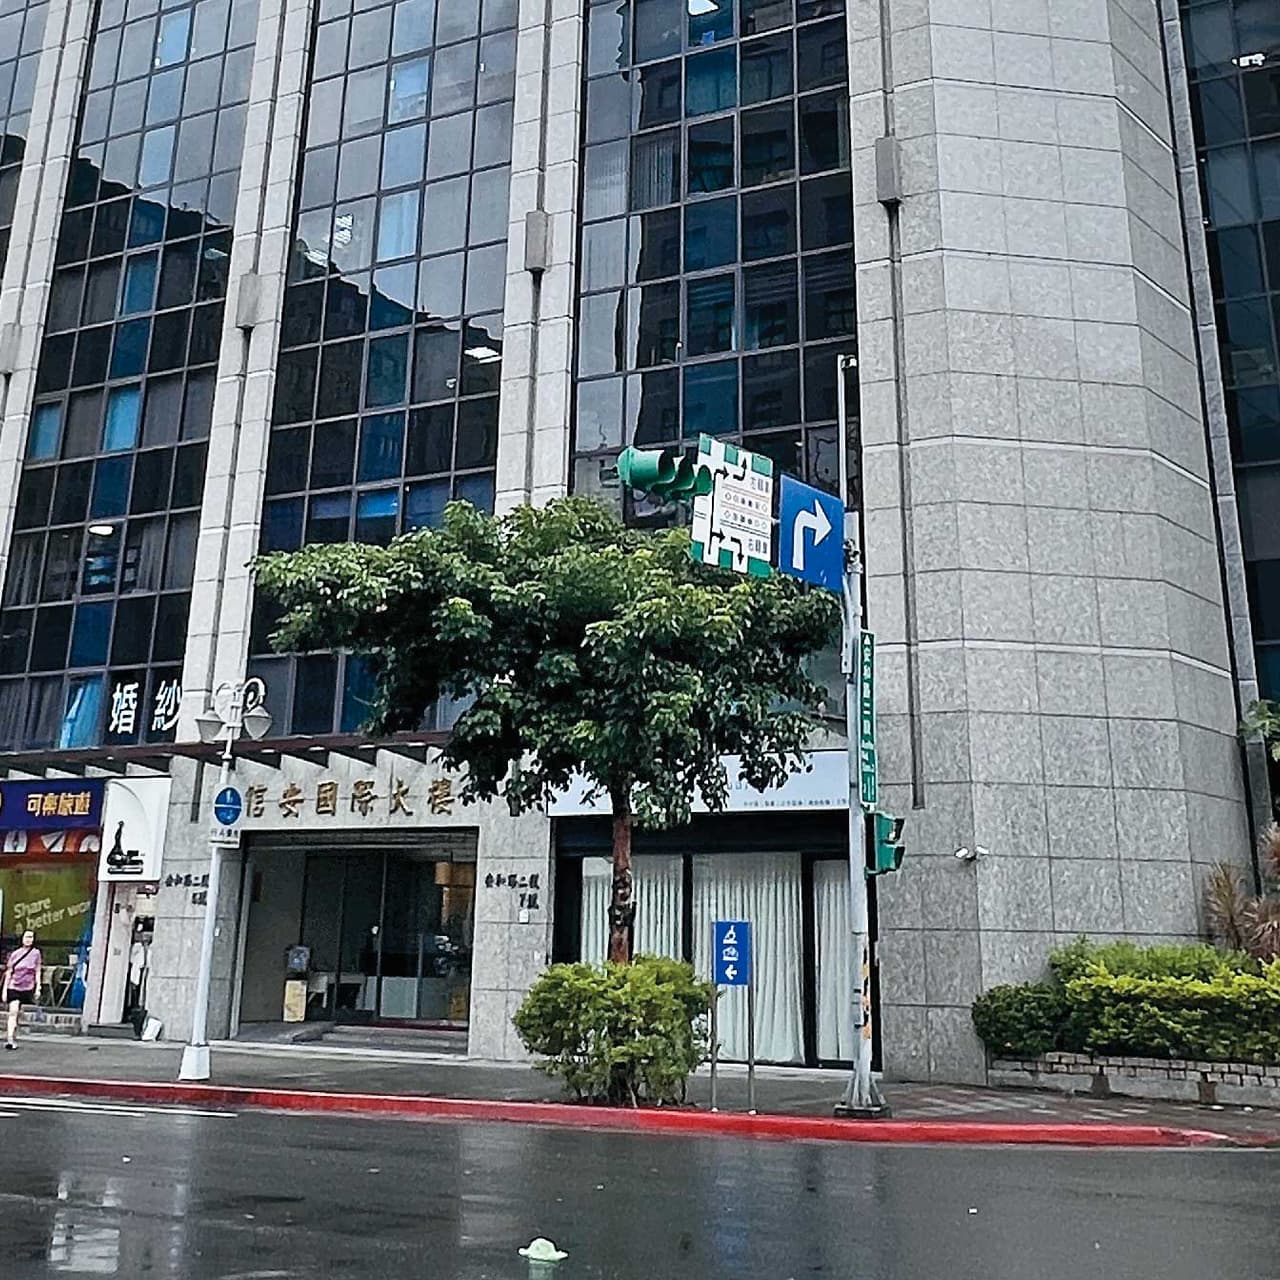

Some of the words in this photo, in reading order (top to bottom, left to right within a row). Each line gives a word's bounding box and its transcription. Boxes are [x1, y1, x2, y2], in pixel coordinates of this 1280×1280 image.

[109, 679, 181, 733] 婚紗
[245, 777, 455, 818] 信安國際大樓
[13, 897, 51, 919] Share
[26, 907, 65, 931] better
